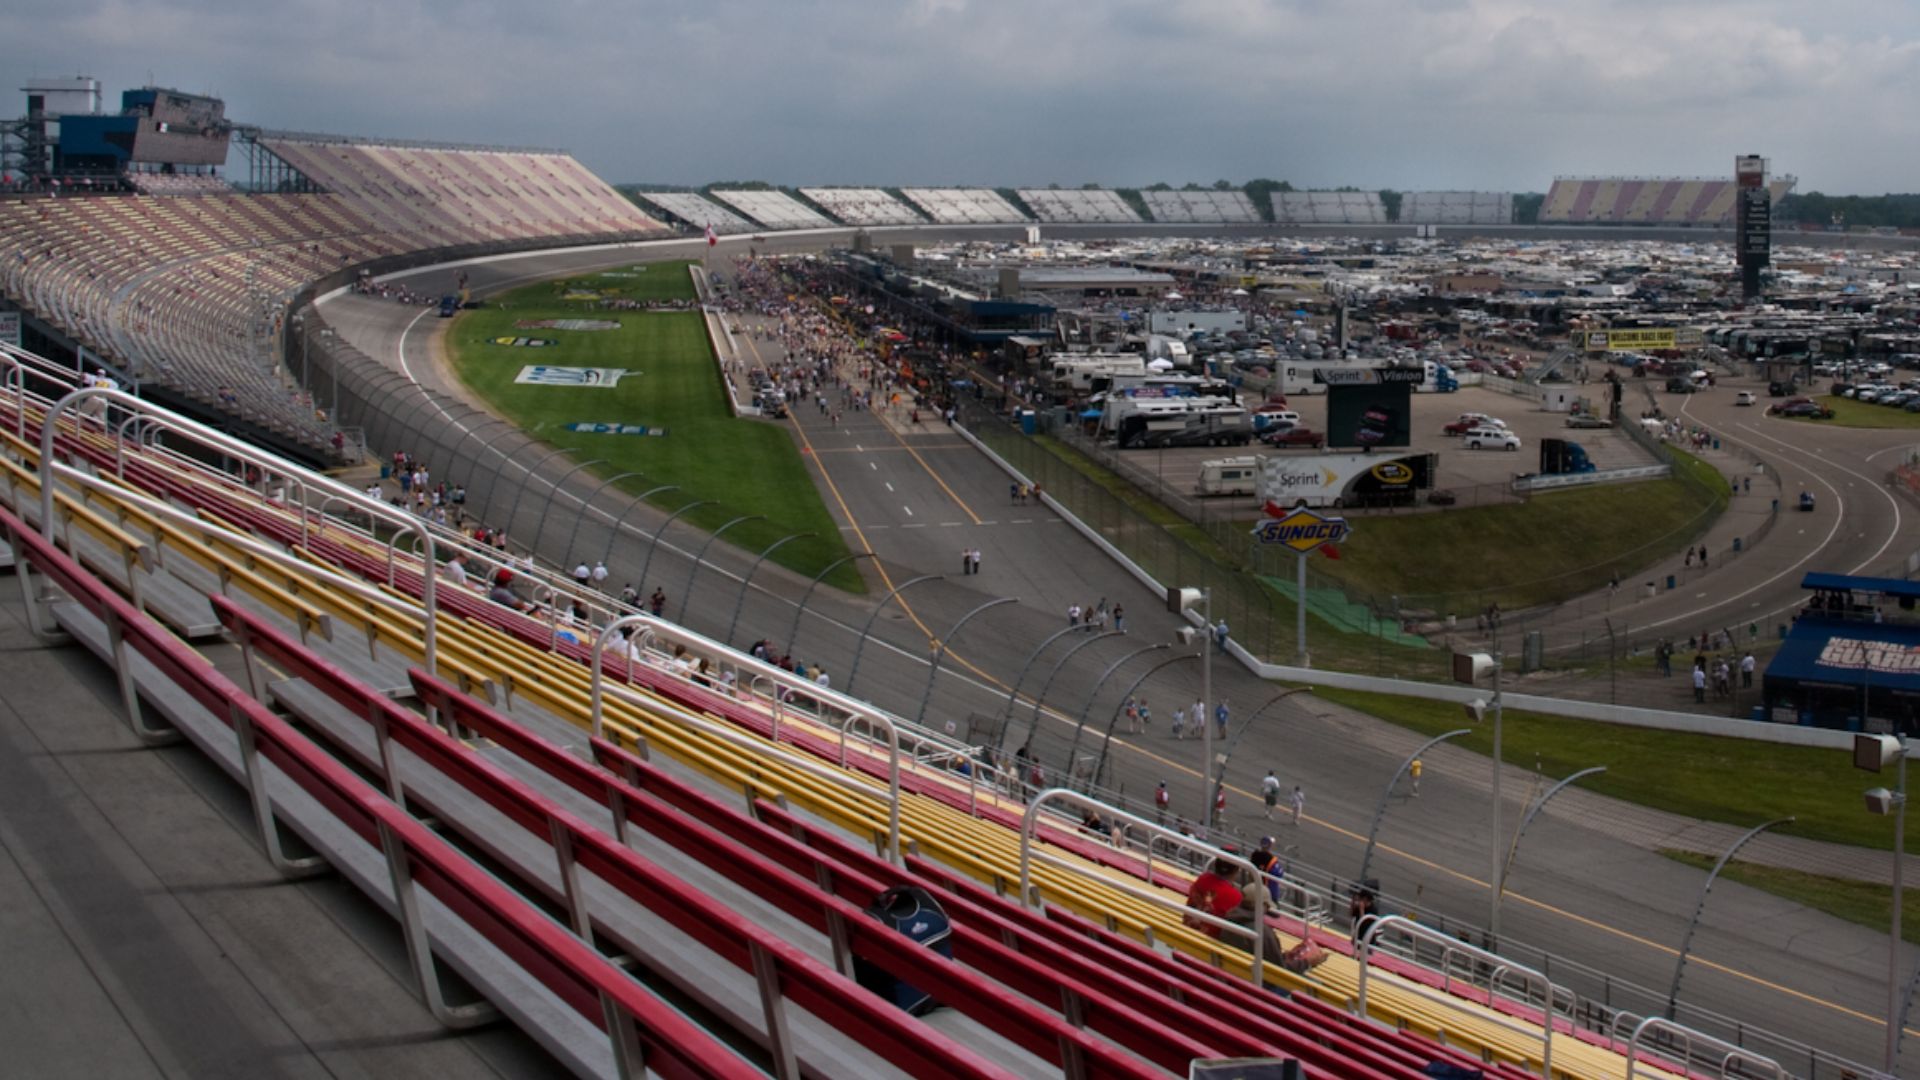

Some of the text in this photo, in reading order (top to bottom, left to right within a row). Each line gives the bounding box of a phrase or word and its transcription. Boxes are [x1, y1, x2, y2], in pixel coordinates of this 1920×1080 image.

[1327, 369, 1423, 382] Sprint Vision
[1281, 472, 1319, 487] Sprint
[1265, 524, 1342, 540] SUNOCO
[1828, 637, 1905, 653] NATIONAL
[1820, 646, 1920, 669] GUARD
